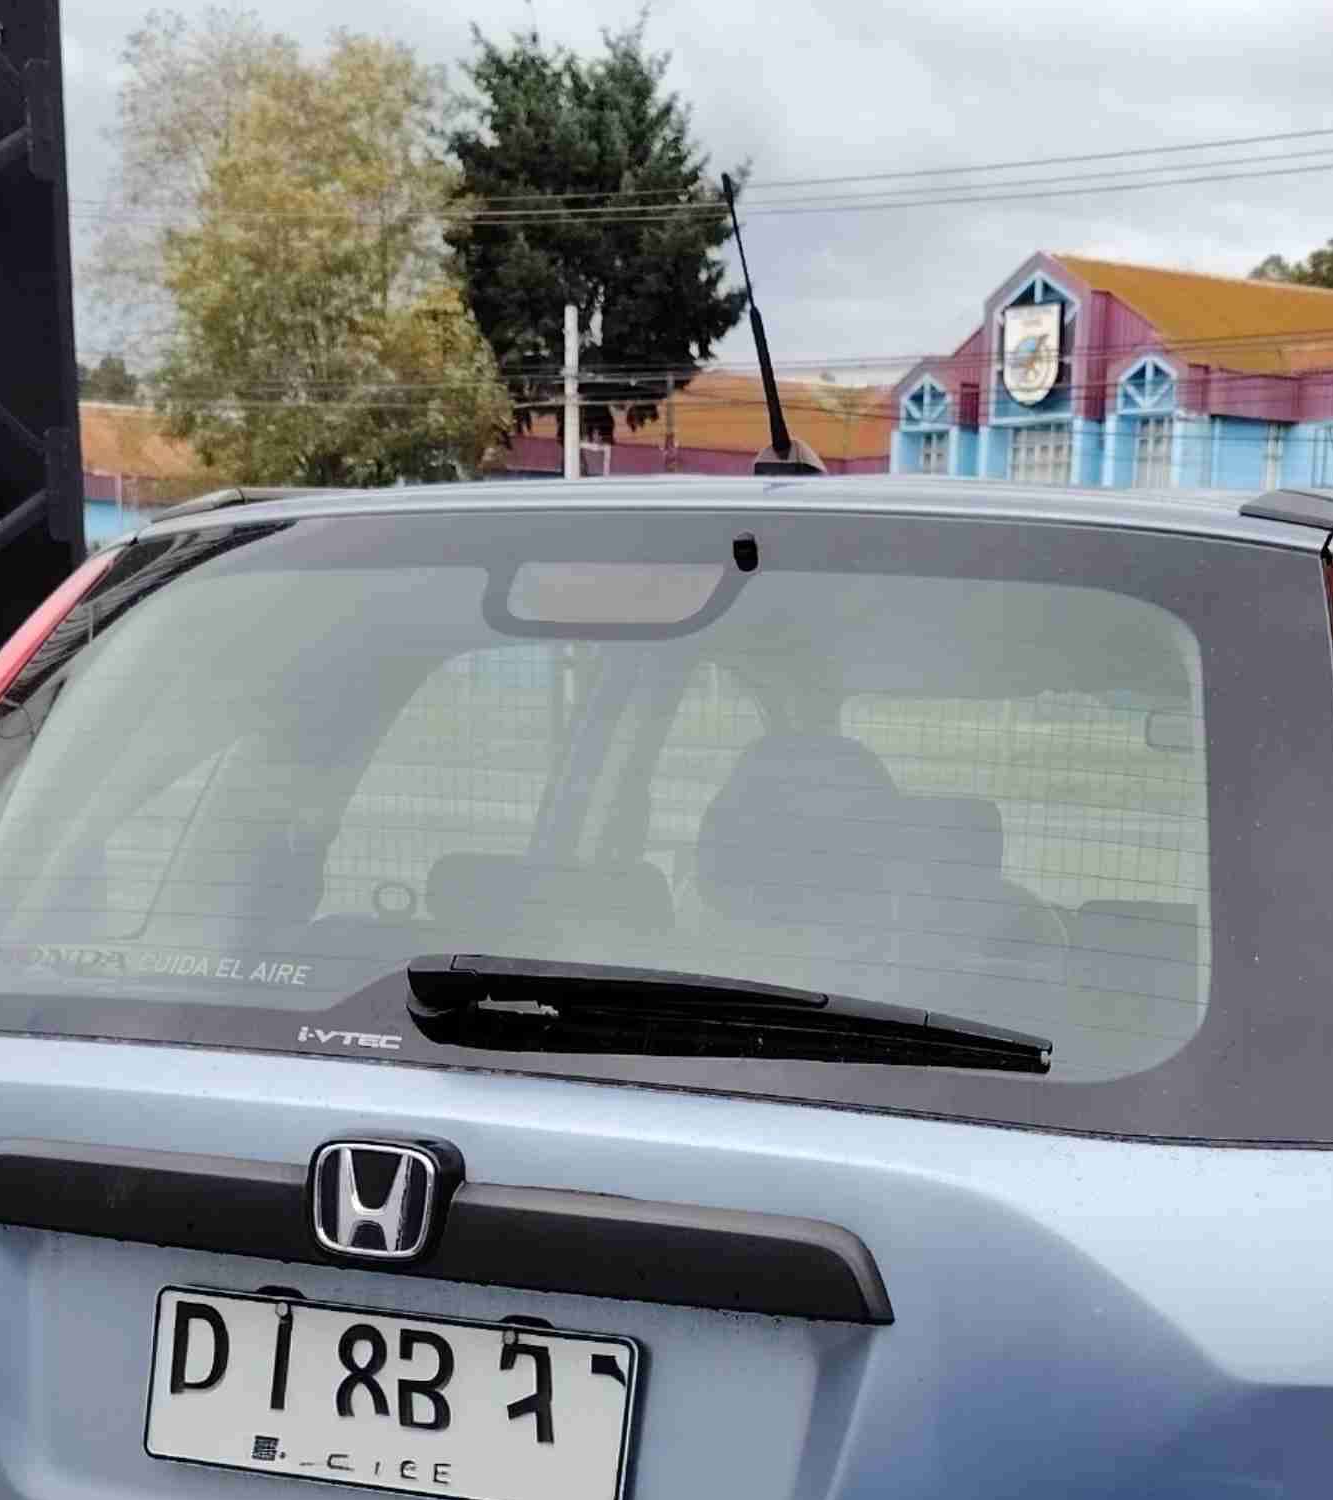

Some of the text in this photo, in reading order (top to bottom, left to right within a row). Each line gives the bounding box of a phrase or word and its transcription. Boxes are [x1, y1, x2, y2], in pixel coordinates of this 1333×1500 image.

[138, 952, 210, 978] CUIDA
[215, 958, 245, 980] EL
[249, 962, 313, 986] AIRE
